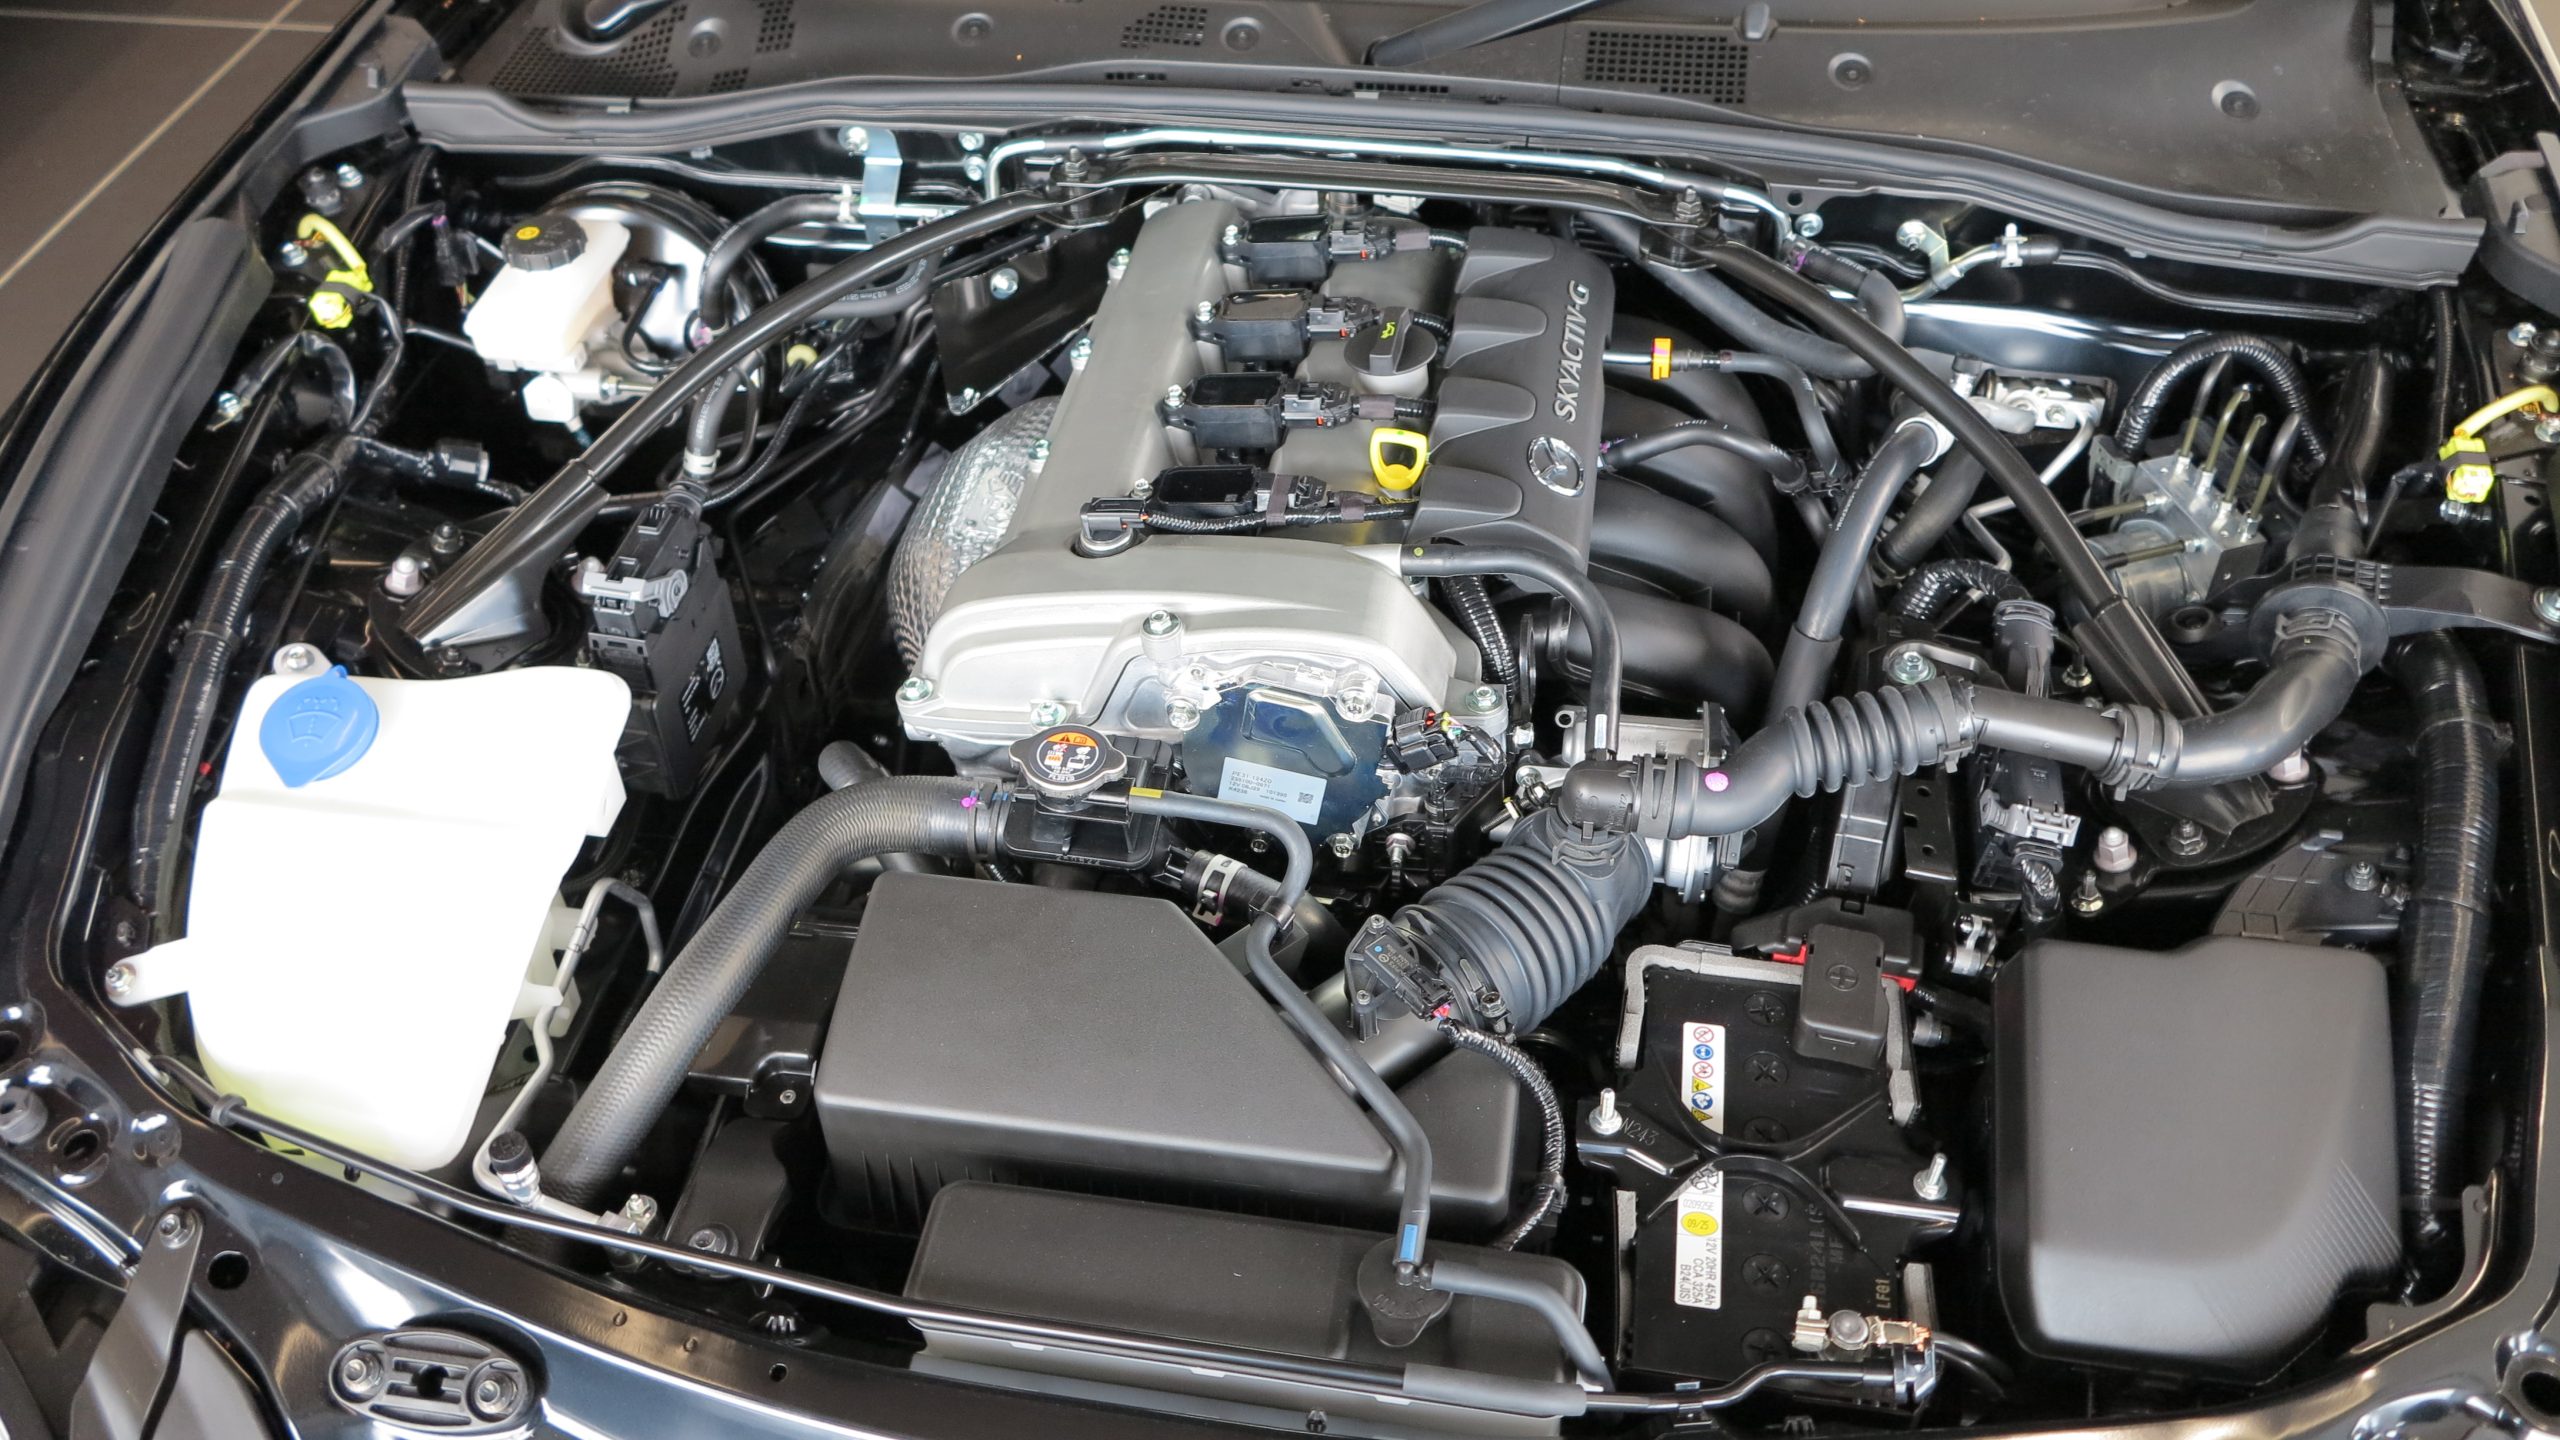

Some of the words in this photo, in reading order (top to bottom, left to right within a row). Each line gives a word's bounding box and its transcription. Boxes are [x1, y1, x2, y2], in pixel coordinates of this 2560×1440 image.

[1554, 280, 1590, 423] SKYACTIV-G
[1687, 1218, 1710, 1231] 09/25
[1705, 1237, 1717, 1255] 12V
[1693, 1257, 1704, 1279] CCA
[1705, 1256, 1717, 1280] 20HR
[1692, 1281, 1704, 1304] 325A
[1704, 1282, 1717, 1306] 45Ah
